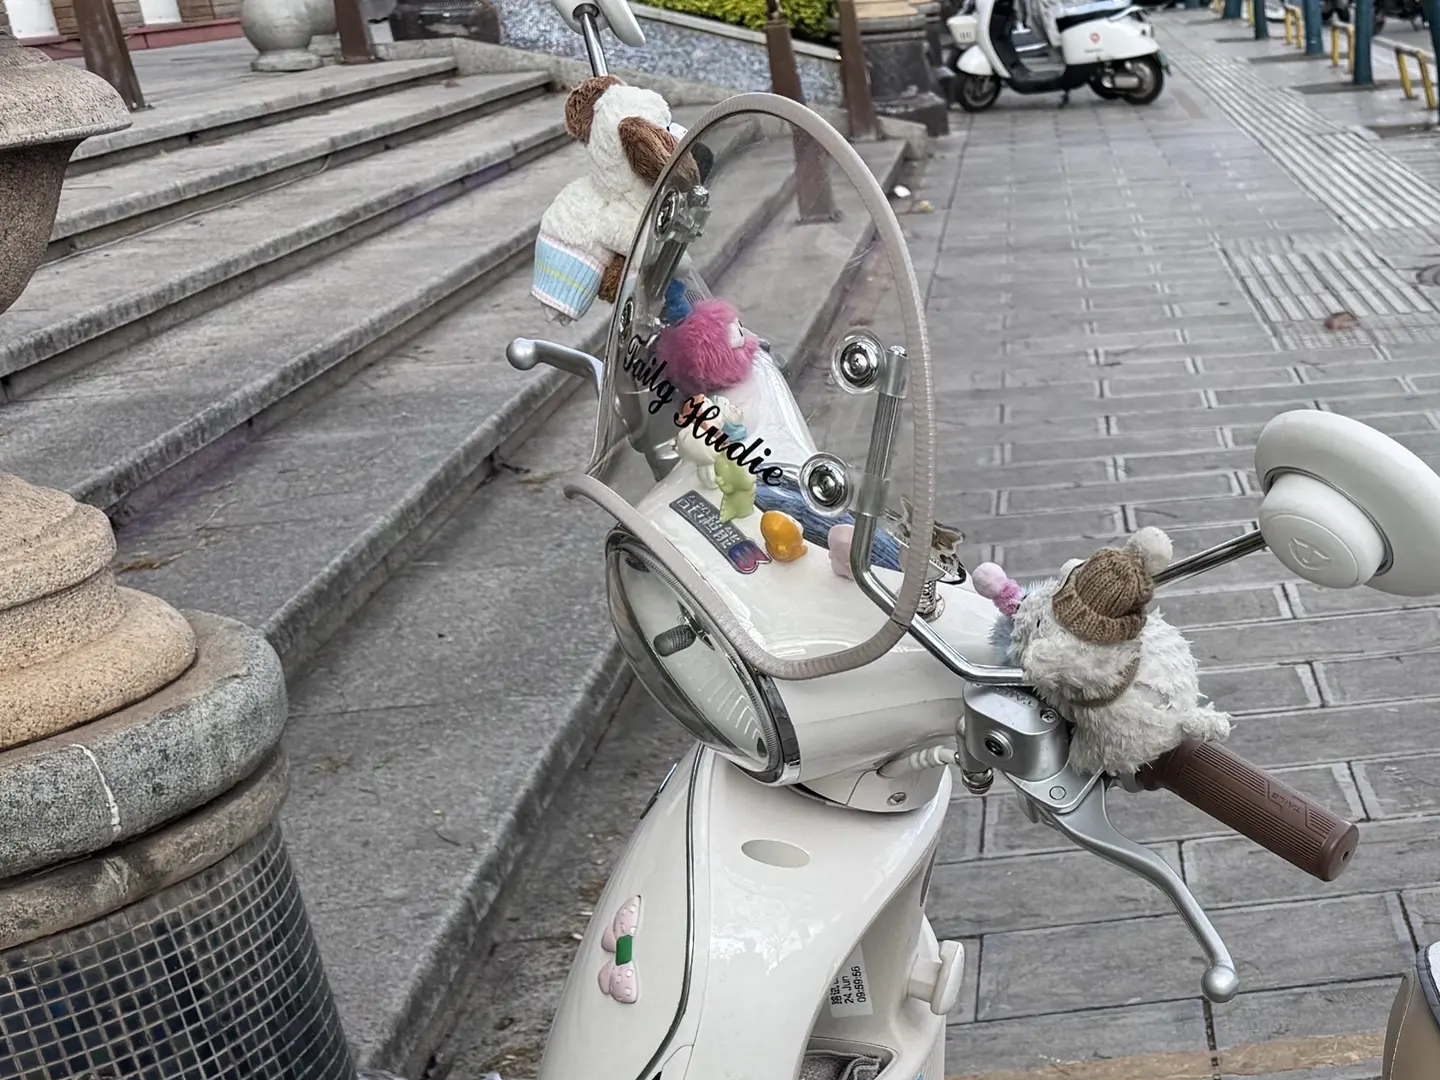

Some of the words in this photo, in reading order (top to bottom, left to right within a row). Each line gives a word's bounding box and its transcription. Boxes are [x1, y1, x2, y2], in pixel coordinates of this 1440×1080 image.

[622, 334, 677, 415] Tailg
[673, 396, 784, 487] Hudie
[842, 975, 852, 991] Jun
[850, 965, 867, 1003] 09:59:56
